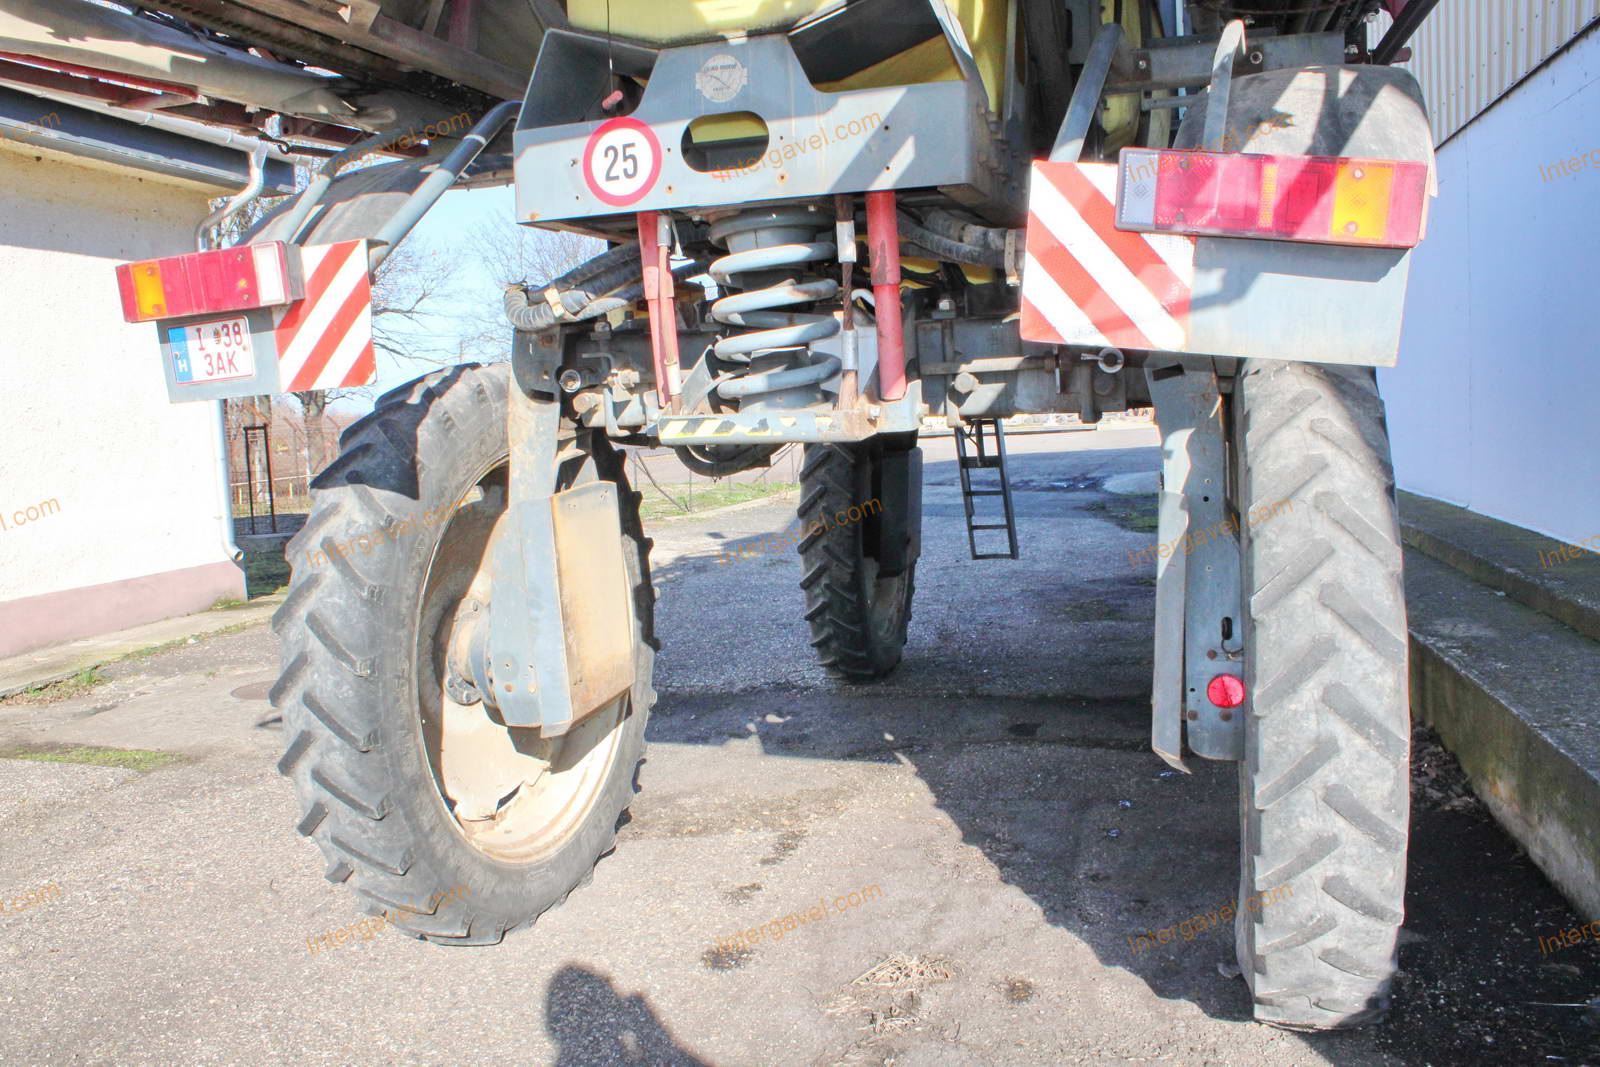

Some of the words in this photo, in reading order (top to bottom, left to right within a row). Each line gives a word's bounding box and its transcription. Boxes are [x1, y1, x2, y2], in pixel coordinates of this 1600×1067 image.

[604, 142, 638, 182] 25
[222, 322, 242, 347] 38
[204, 350, 239, 377] 3AK
